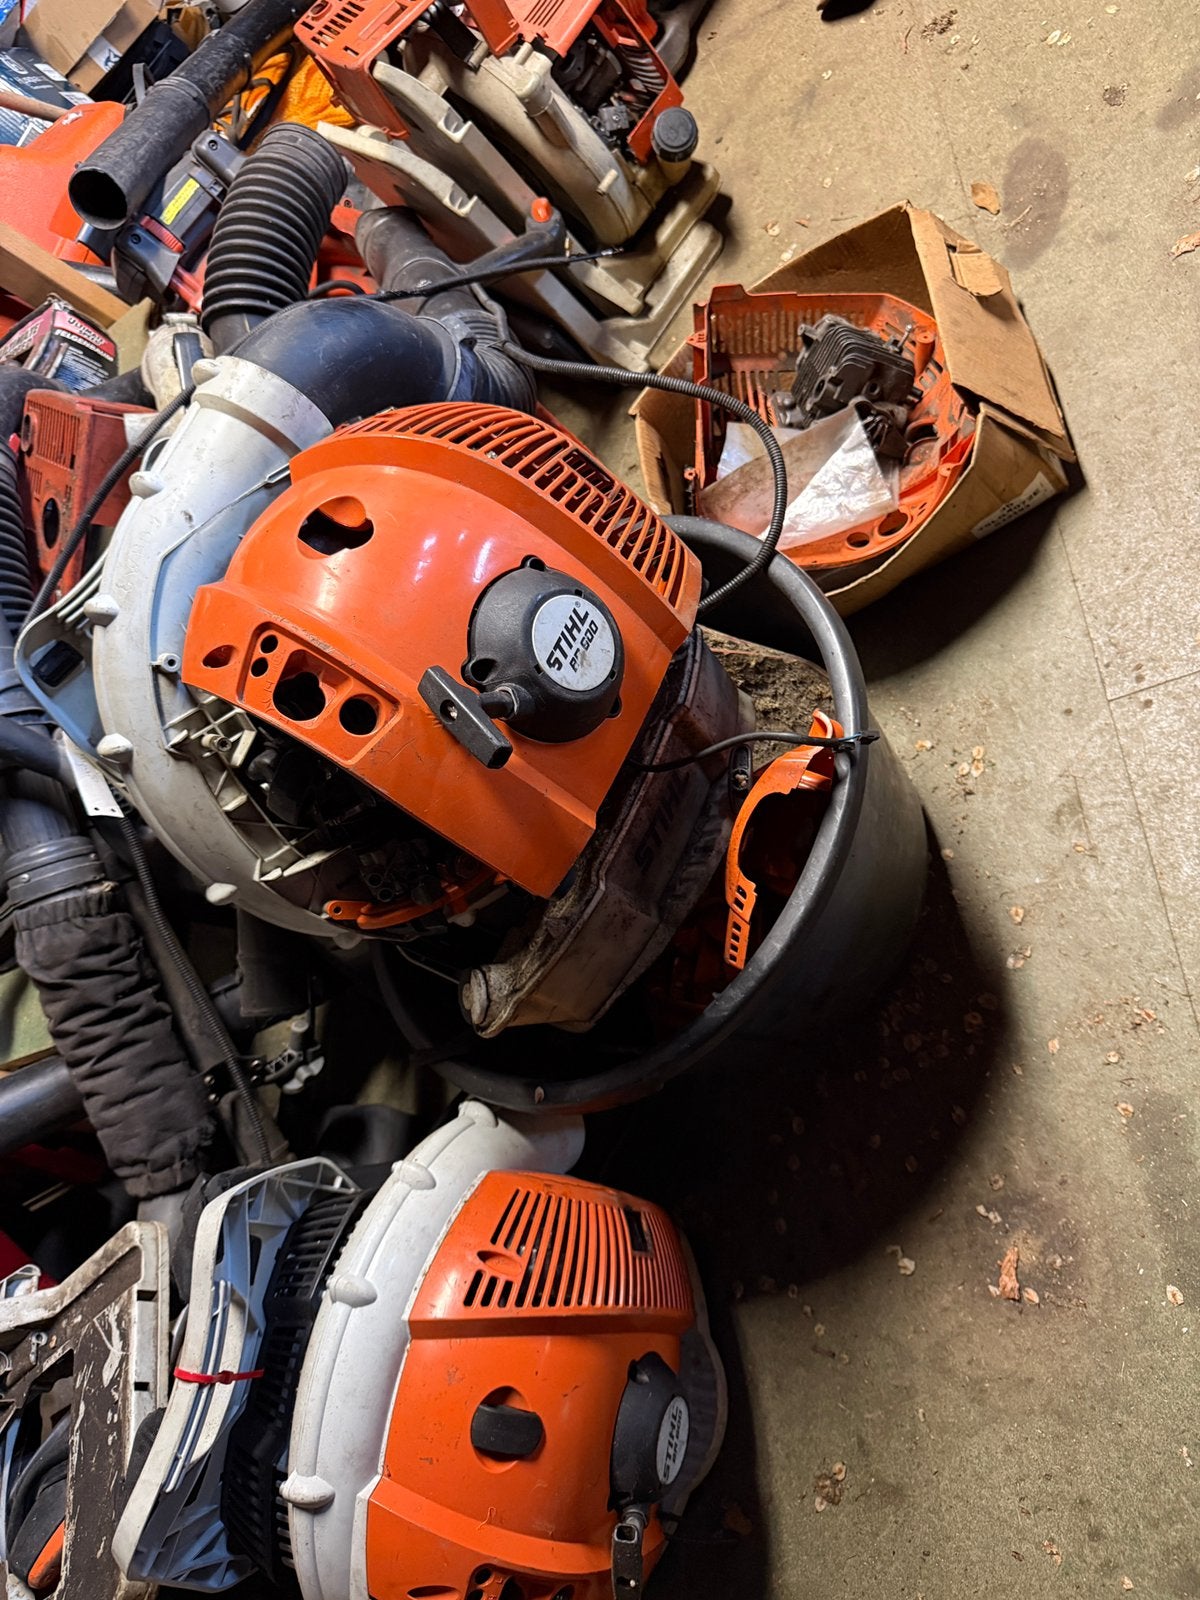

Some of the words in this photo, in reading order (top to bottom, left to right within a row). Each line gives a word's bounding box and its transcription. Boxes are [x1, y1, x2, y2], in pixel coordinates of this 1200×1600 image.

[546, 607, 590, 671] STIHL
[580, 620, 599, 651] 600
[634, 771, 690, 873] STIHL
[663, 1405, 680, 1480] STIHL
